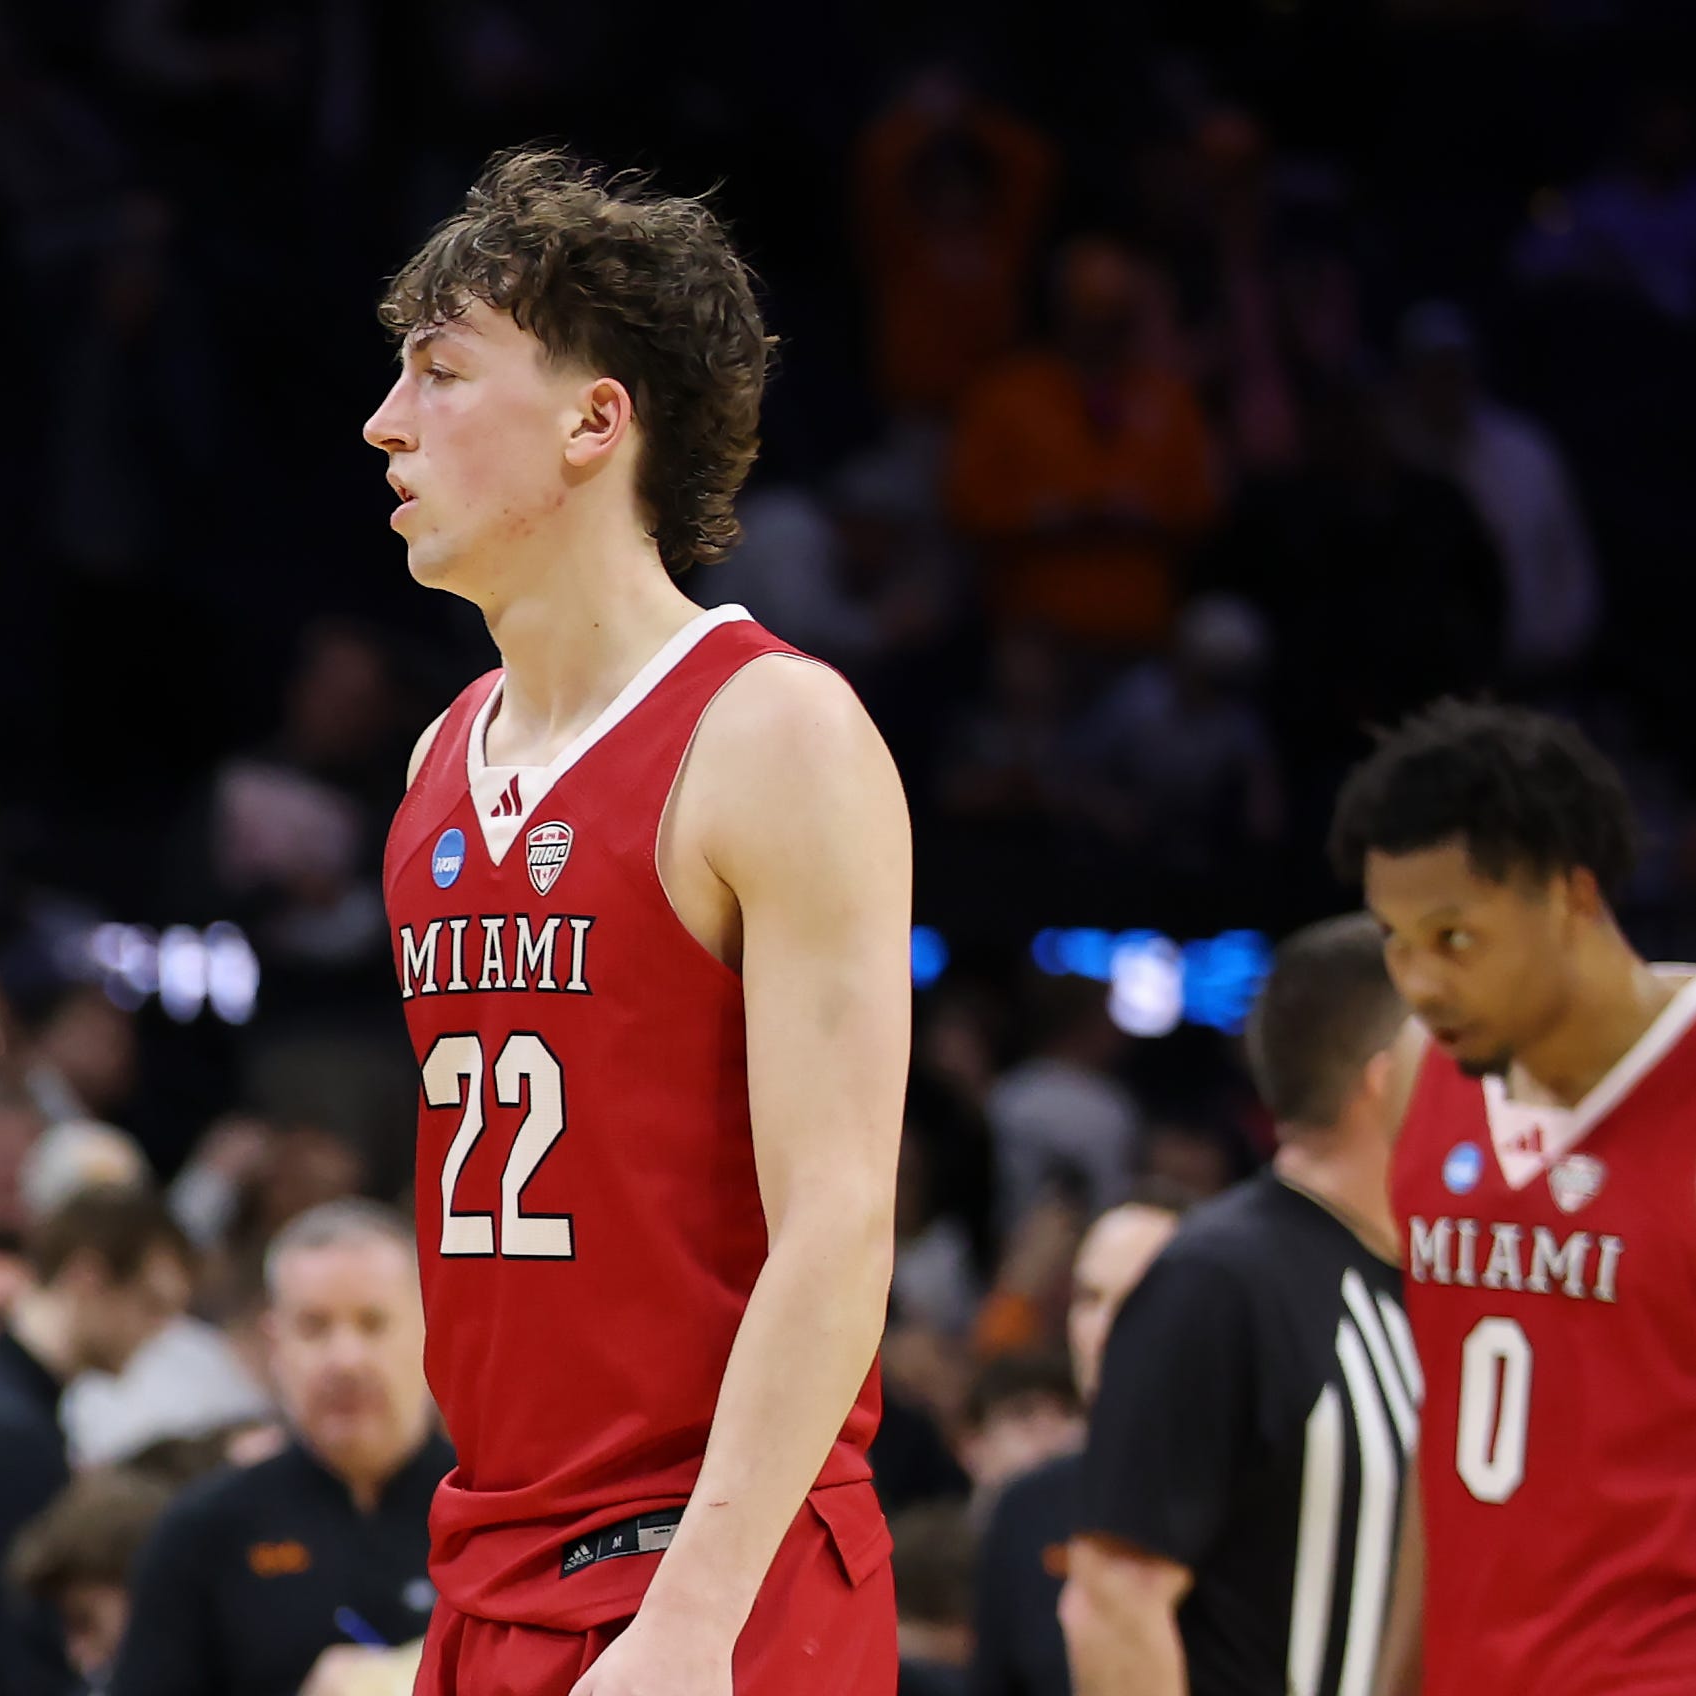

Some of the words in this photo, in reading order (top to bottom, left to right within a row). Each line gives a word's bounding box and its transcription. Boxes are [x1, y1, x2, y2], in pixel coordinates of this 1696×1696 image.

[528, 846, 566, 865] MAC
[400, 914, 595, 999] MIAMI
[420, 1031, 574, 1259] 22
[1409, 1215, 1623, 1303] MIAMI
[1456, 1315, 1532, 1504] 0
